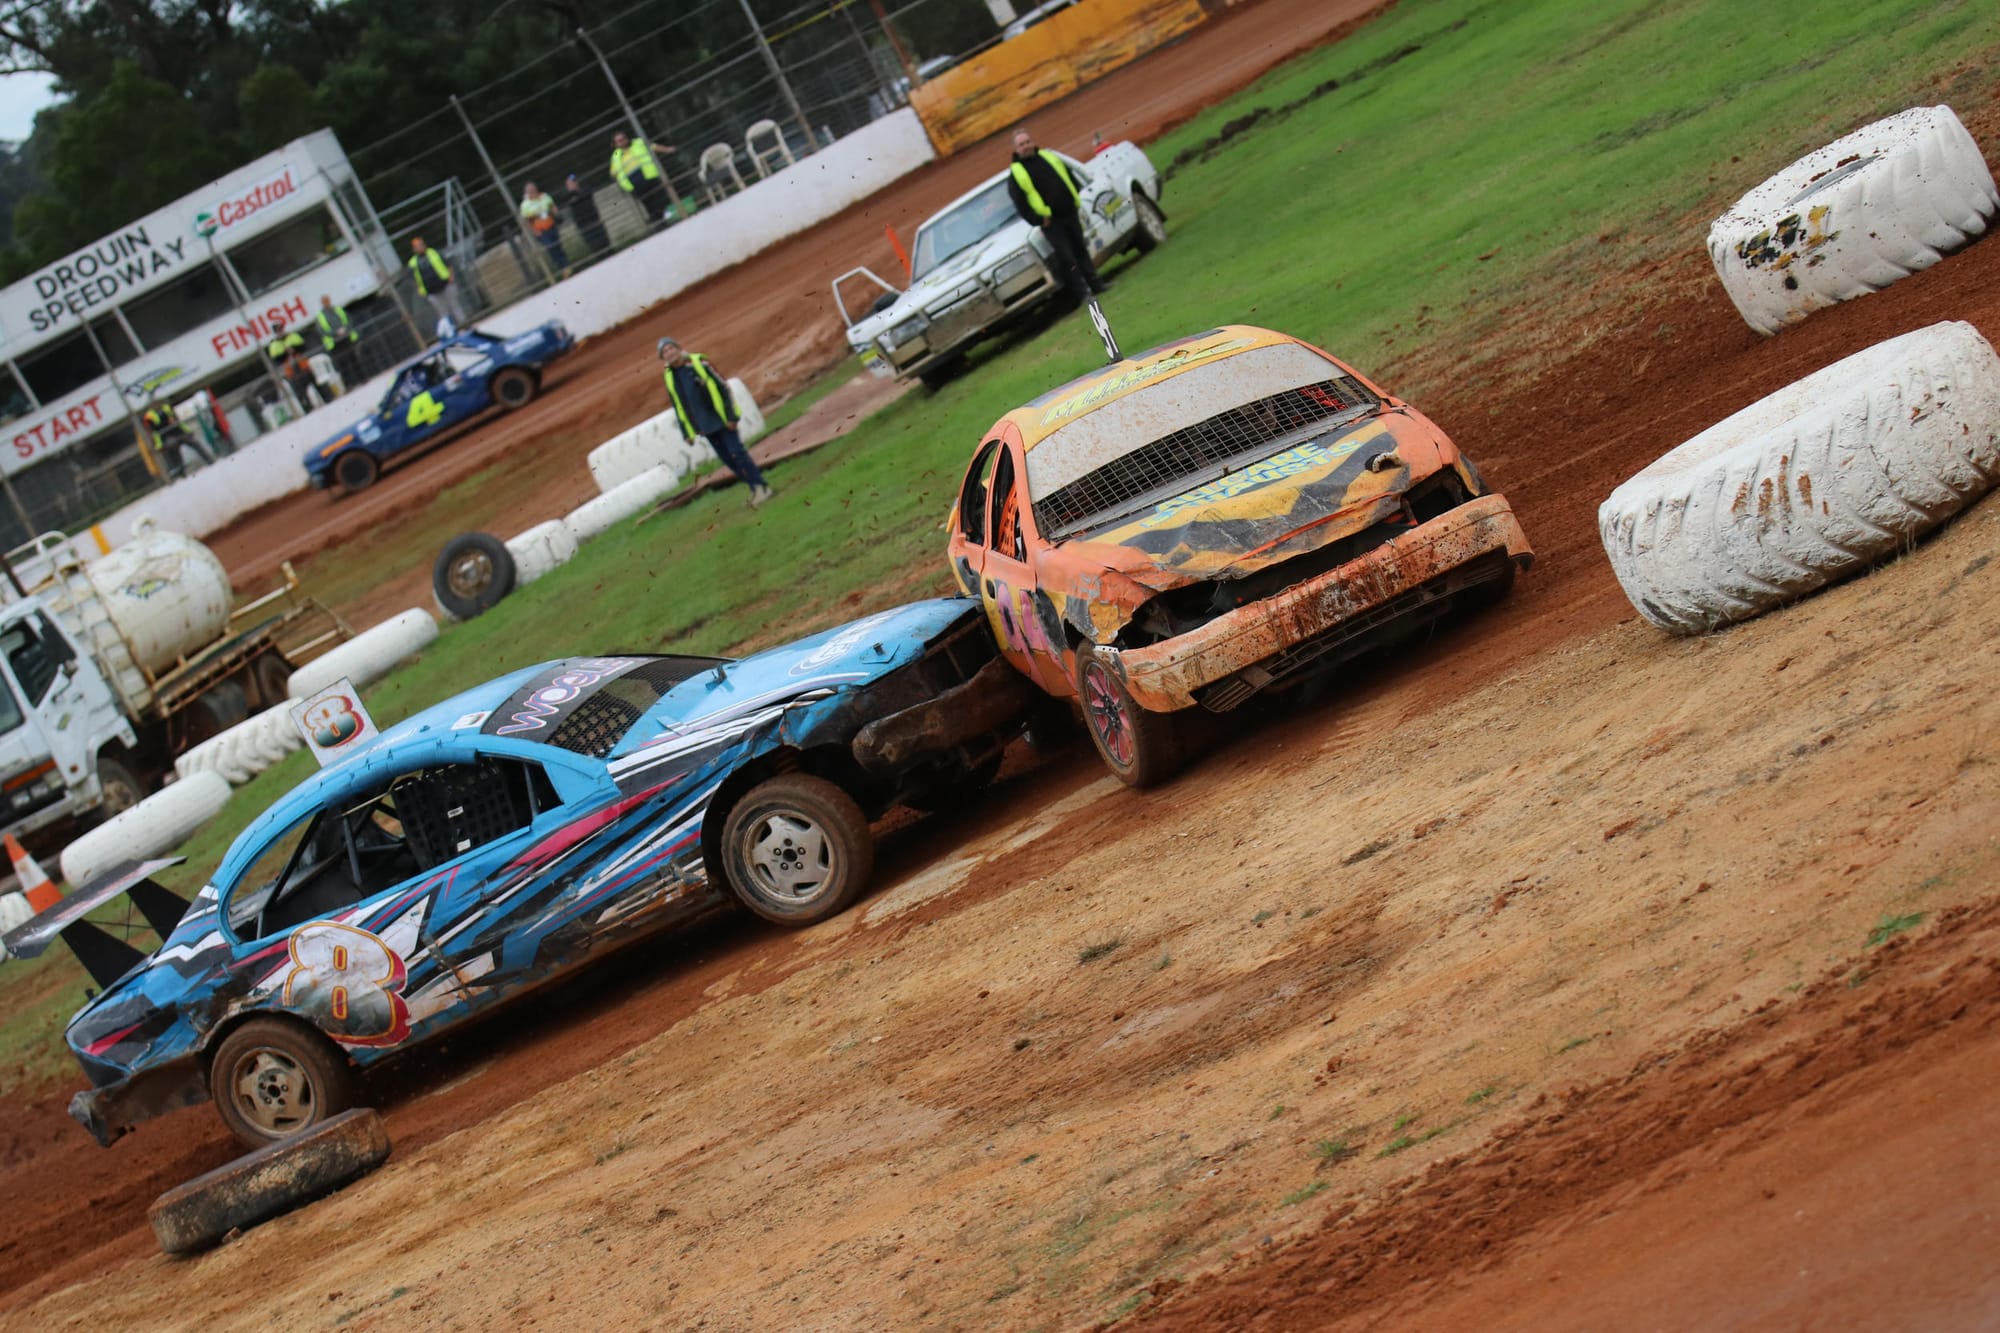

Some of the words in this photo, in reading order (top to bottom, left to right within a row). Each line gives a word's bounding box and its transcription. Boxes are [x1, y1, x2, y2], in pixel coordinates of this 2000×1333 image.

[218, 170, 296, 227] Castrol
[29, 236, 184, 332] SPEEDWAY
[35, 226, 151, 300] DROUIN
[211, 295, 308, 359] FINISH
[12, 394, 103, 459] START
[406, 390, 445, 428] 4
[1155, 441, 1328, 514] ALLCARE
[303, 695, 365, 748] 8
[283, 920, 412, 1047] 8
